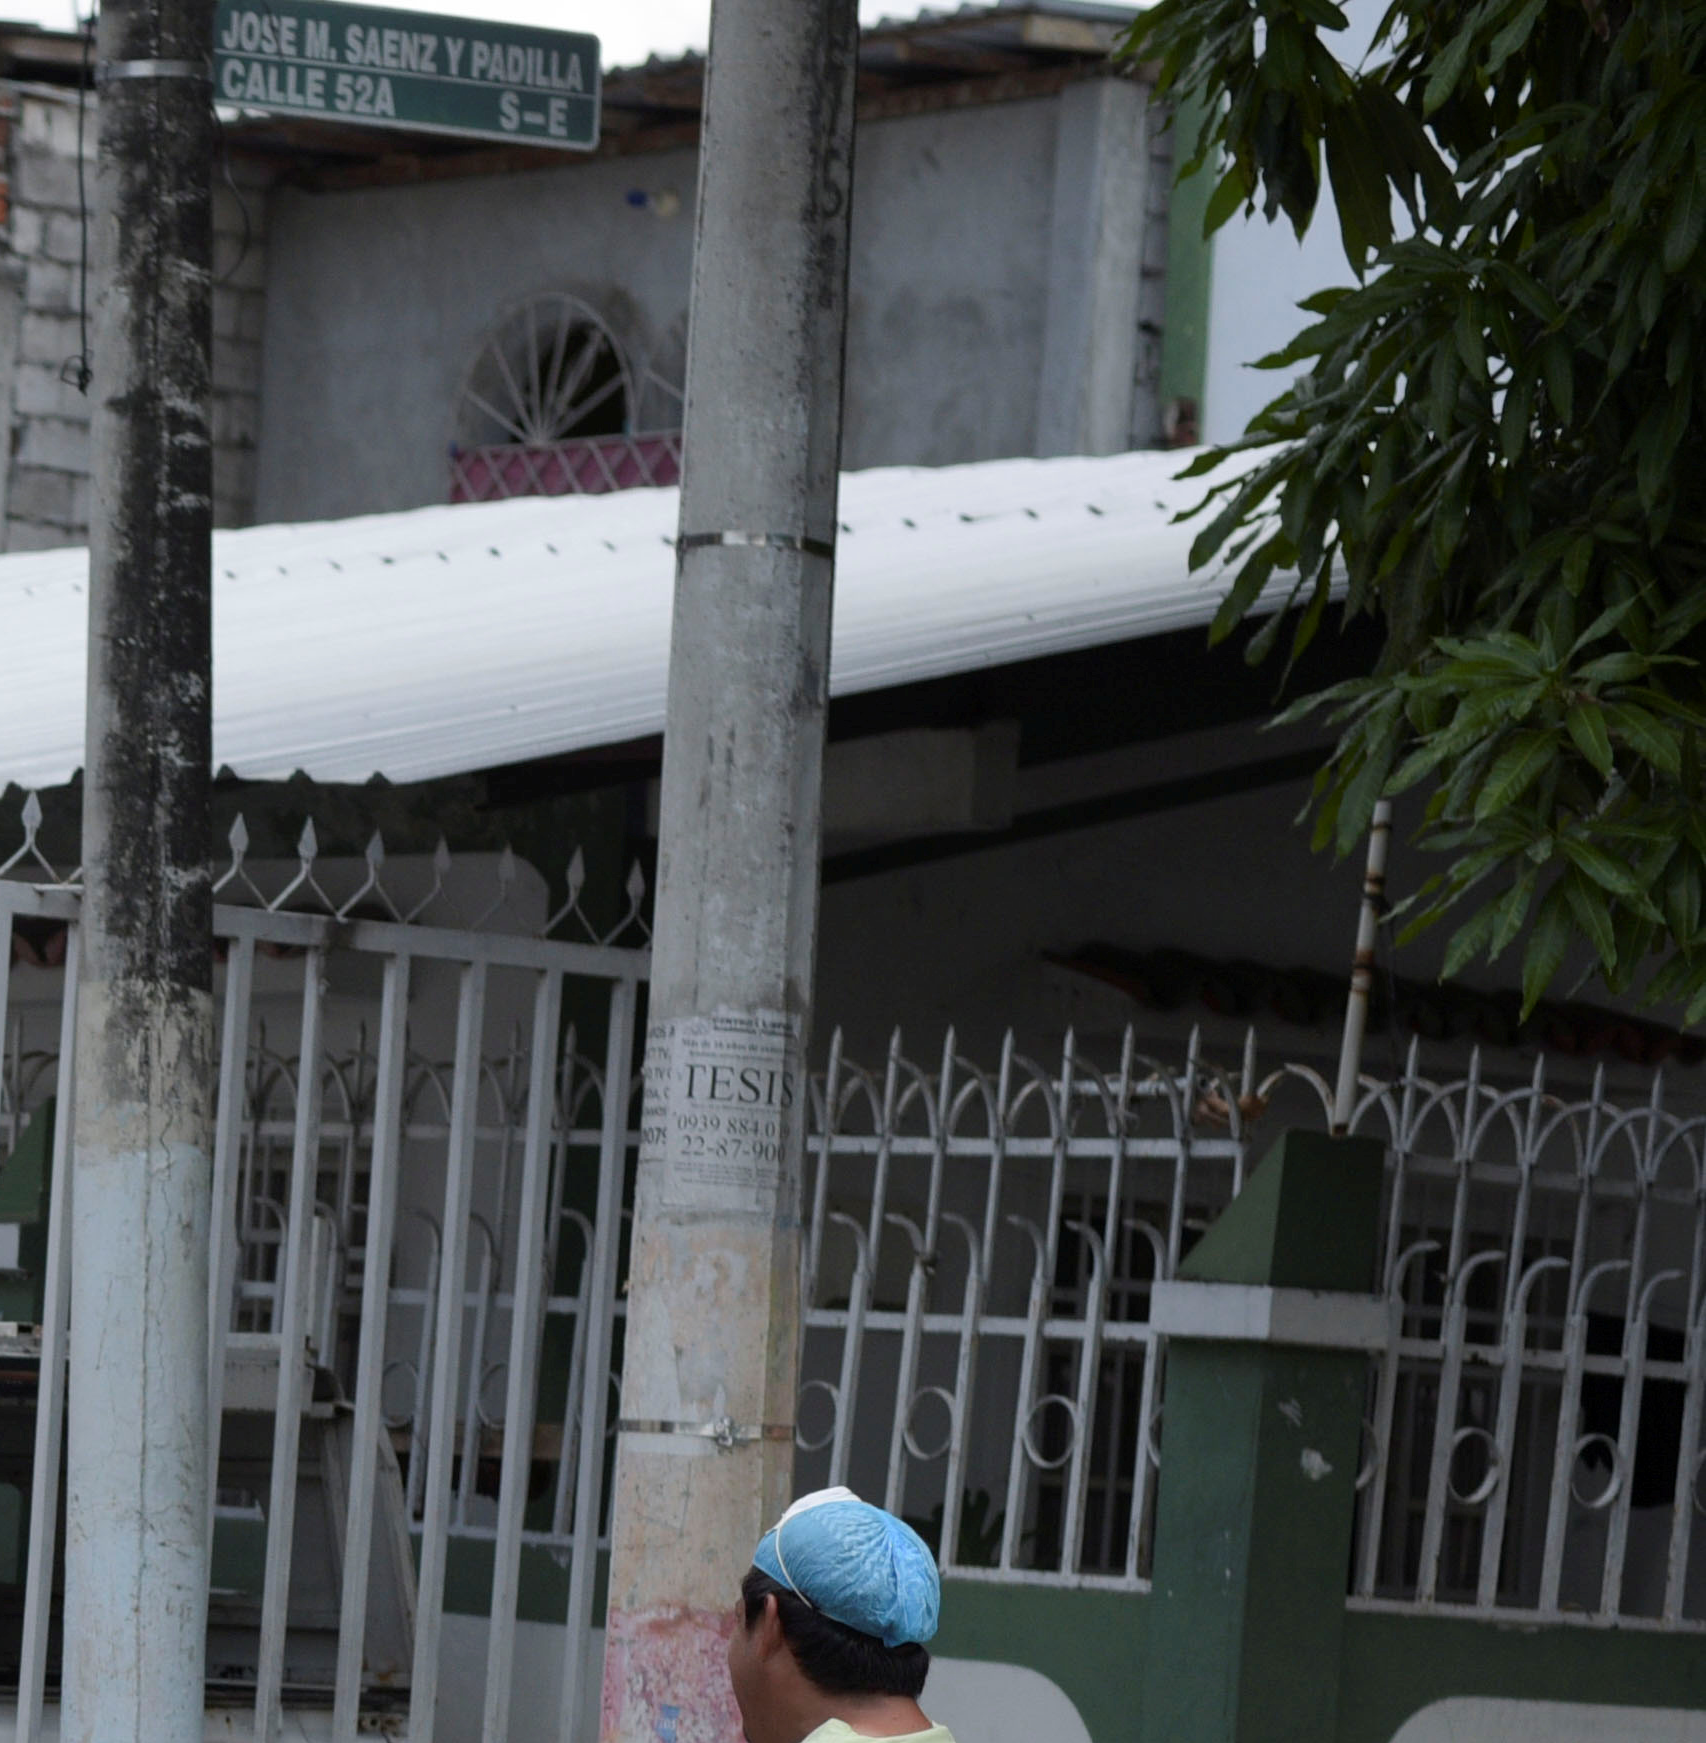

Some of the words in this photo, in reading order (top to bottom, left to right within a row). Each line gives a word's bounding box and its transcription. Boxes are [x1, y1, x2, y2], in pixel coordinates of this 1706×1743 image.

[222, 10, 298, 56] JOSE
[305, 18, 338, 61] M.
[345, 23, 438, 73] SAENZ
[444, 36, 465, 76] Y
[471, 39, 584, 92] PADILLA
[222, 58, 326, 107] CALLE
[334, 72, 396, 117] 52A
[686, 1063, 794, 1110] TESIS
